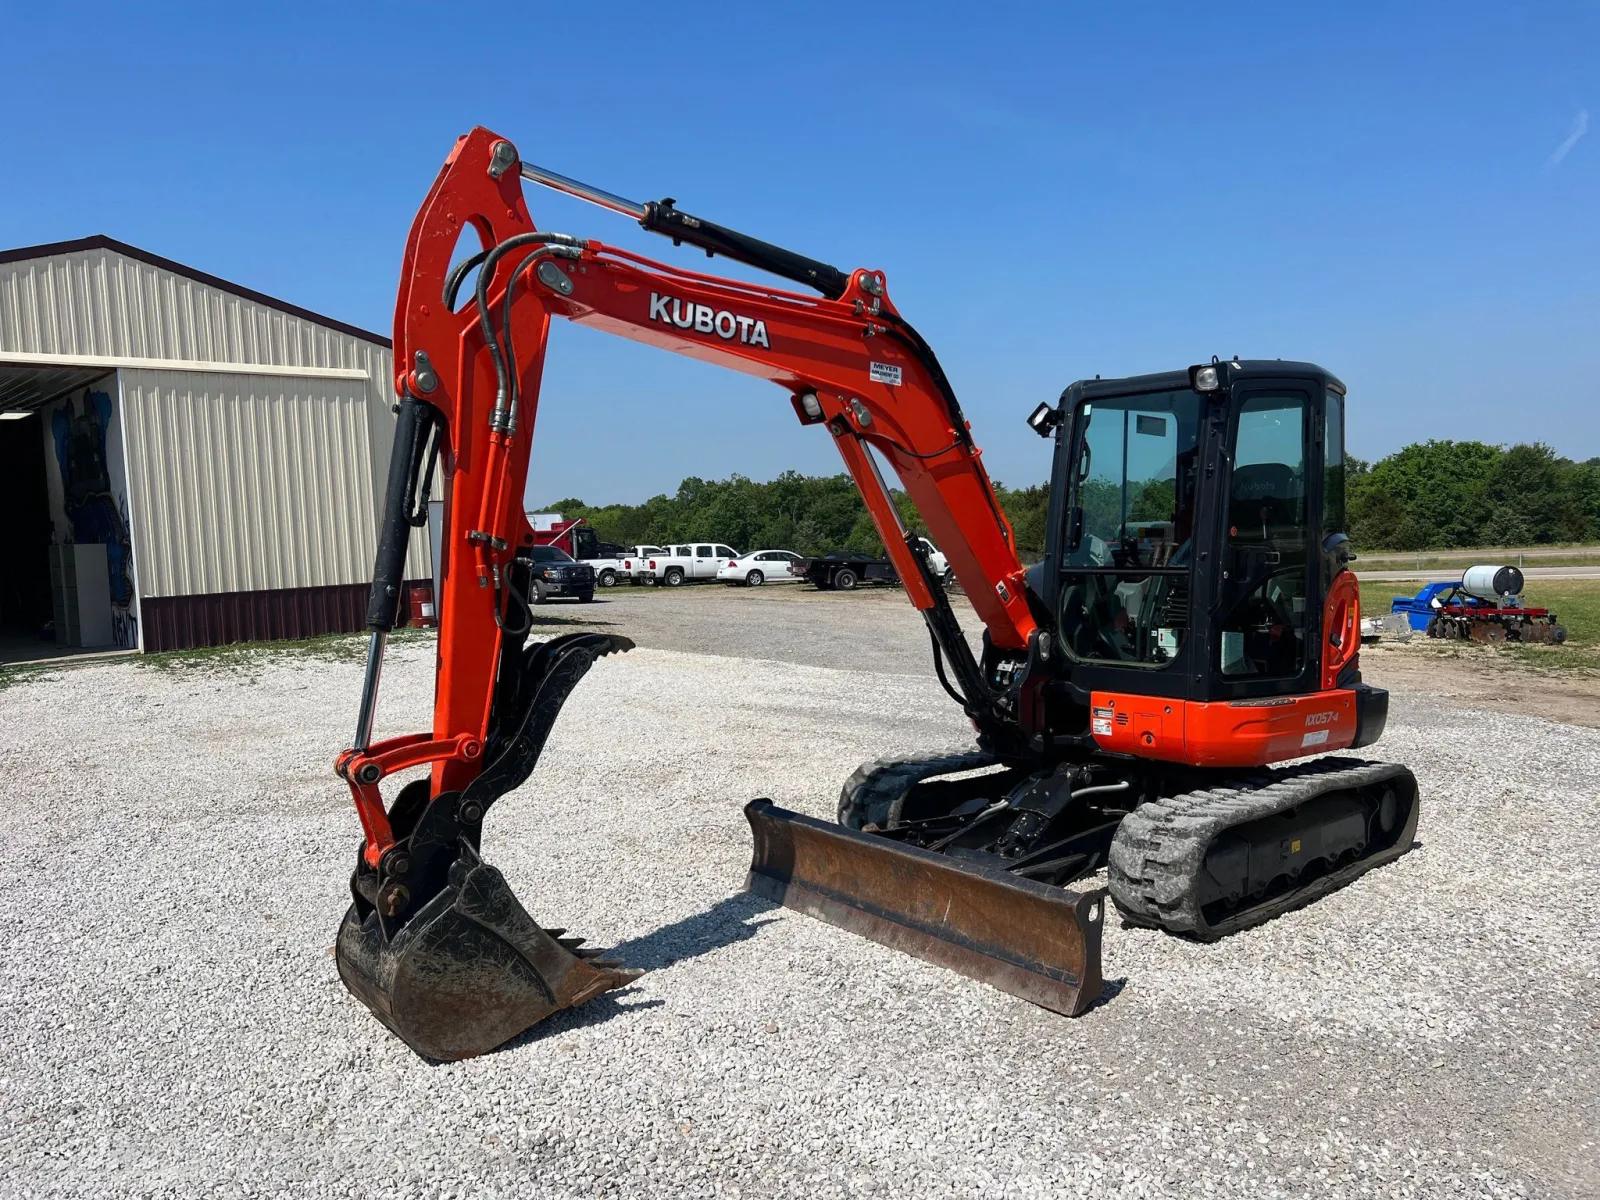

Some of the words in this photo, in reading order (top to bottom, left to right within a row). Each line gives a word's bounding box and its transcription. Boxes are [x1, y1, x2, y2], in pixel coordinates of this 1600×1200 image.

[648, 291, 770, 349] KUBOTA
[873, 363, 898, 373] MEYER
[1304, 711, 1339, 726] KX057-4
